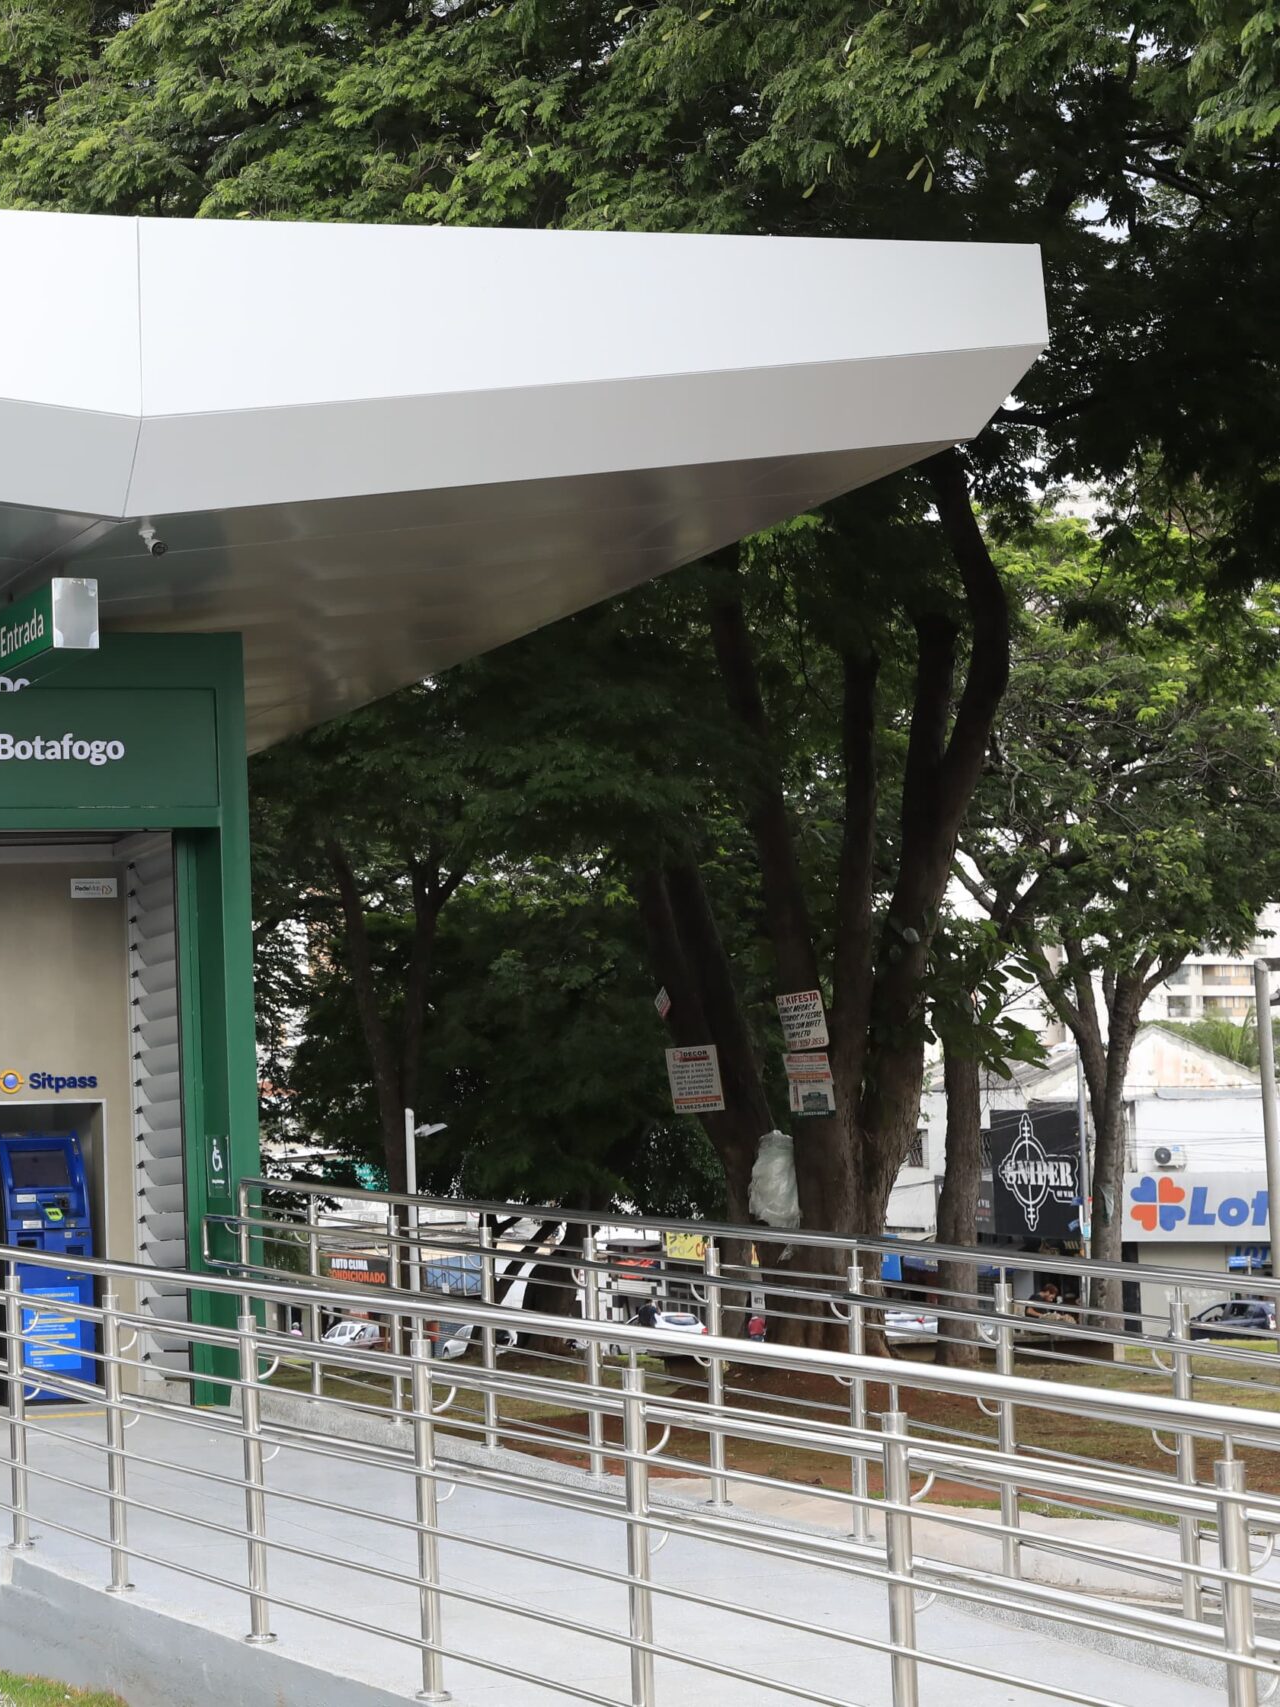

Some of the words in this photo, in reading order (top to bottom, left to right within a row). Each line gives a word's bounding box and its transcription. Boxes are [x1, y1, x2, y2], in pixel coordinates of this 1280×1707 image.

[0, 607, 44, 658] Entrada
[785, 991, 819, 1005] KIFESTA
[28, 1071, 98, 1093] Sitpass
[1004, 1159, 1074, 1187] SNIPER
[331, 1257, 347, 1269] AUTO
[348, 1258, 368, 1271] CLIMA
